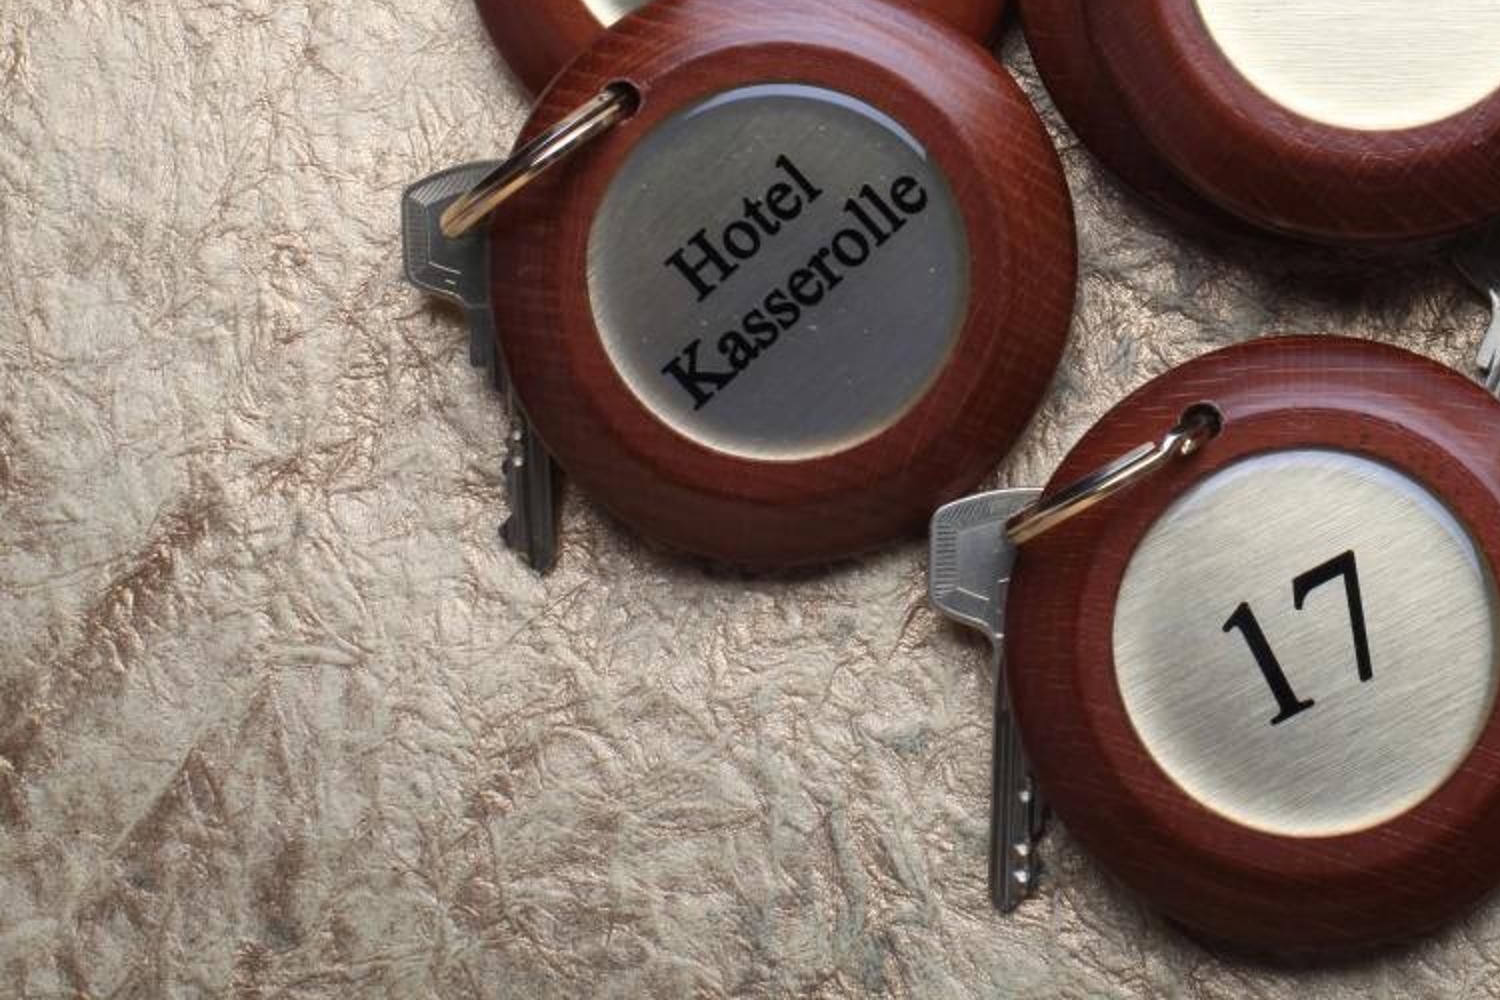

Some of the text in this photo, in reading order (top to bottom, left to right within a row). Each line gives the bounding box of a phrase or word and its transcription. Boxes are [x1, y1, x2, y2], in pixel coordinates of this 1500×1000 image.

[662, 175, 928, 411] Kasserolle
[663, 155, 823, 302] Hotel
[1222, 549, 1375, 727] 17
